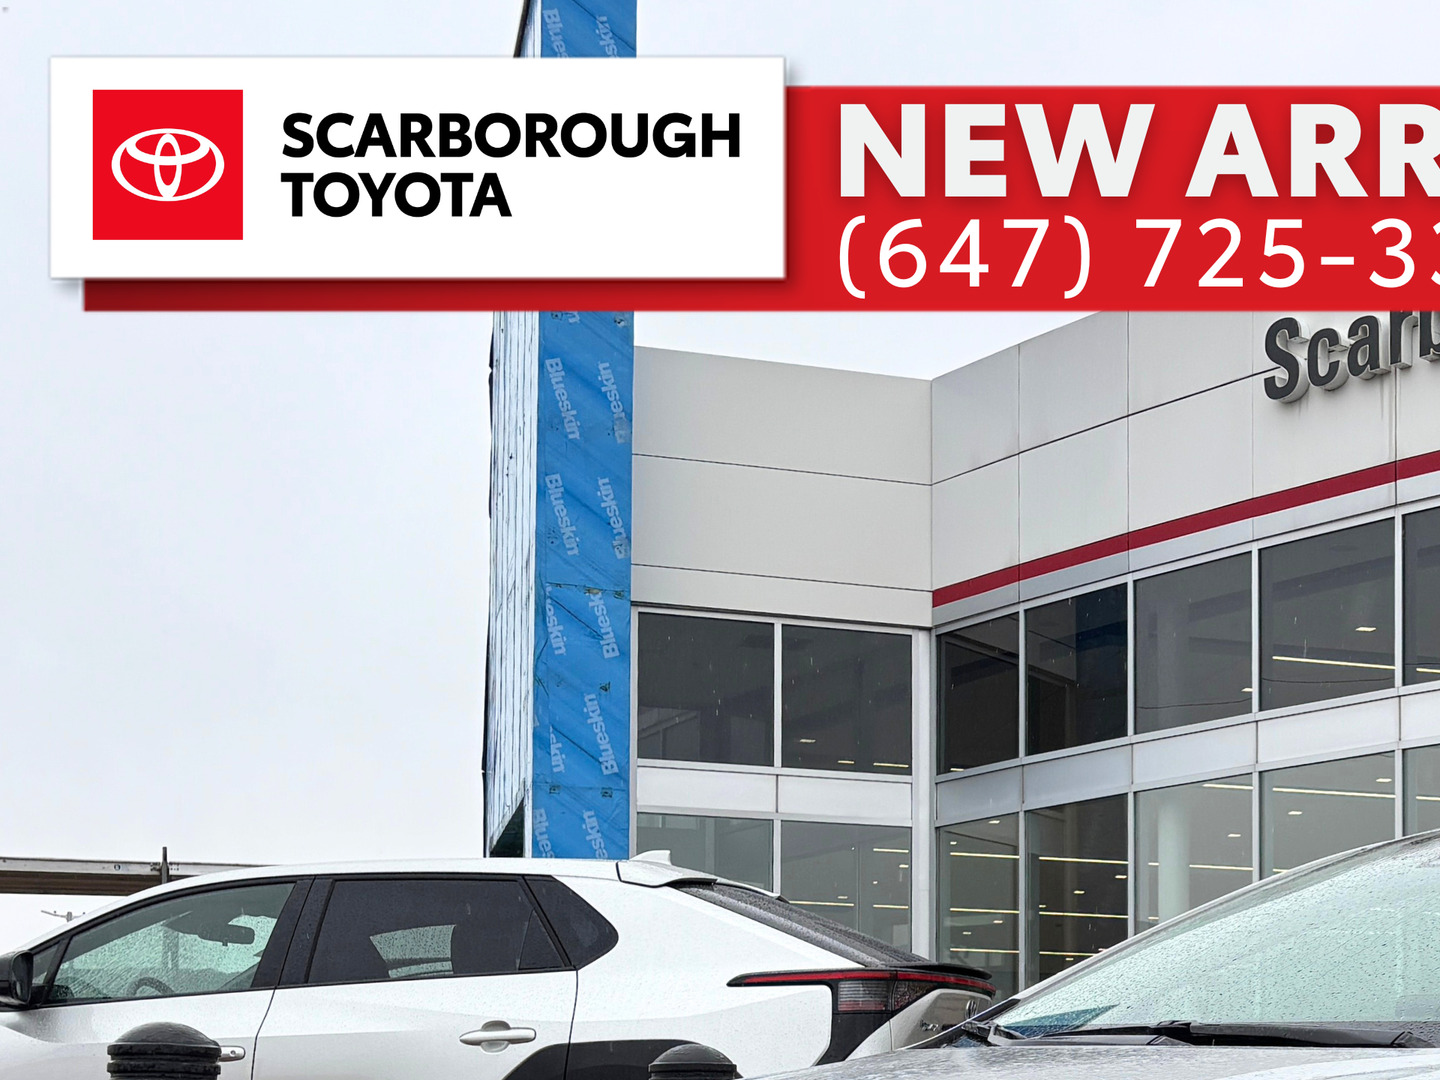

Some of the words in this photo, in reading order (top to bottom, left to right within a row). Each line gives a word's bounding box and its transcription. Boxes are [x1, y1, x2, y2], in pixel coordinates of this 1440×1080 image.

[545, 357, 580, 440] Blueskin
[545, 473, 580, 556] Blueskin
[588, 592, 620, 659] Bluesk
[583, 693, 620, 776] Blueskin
